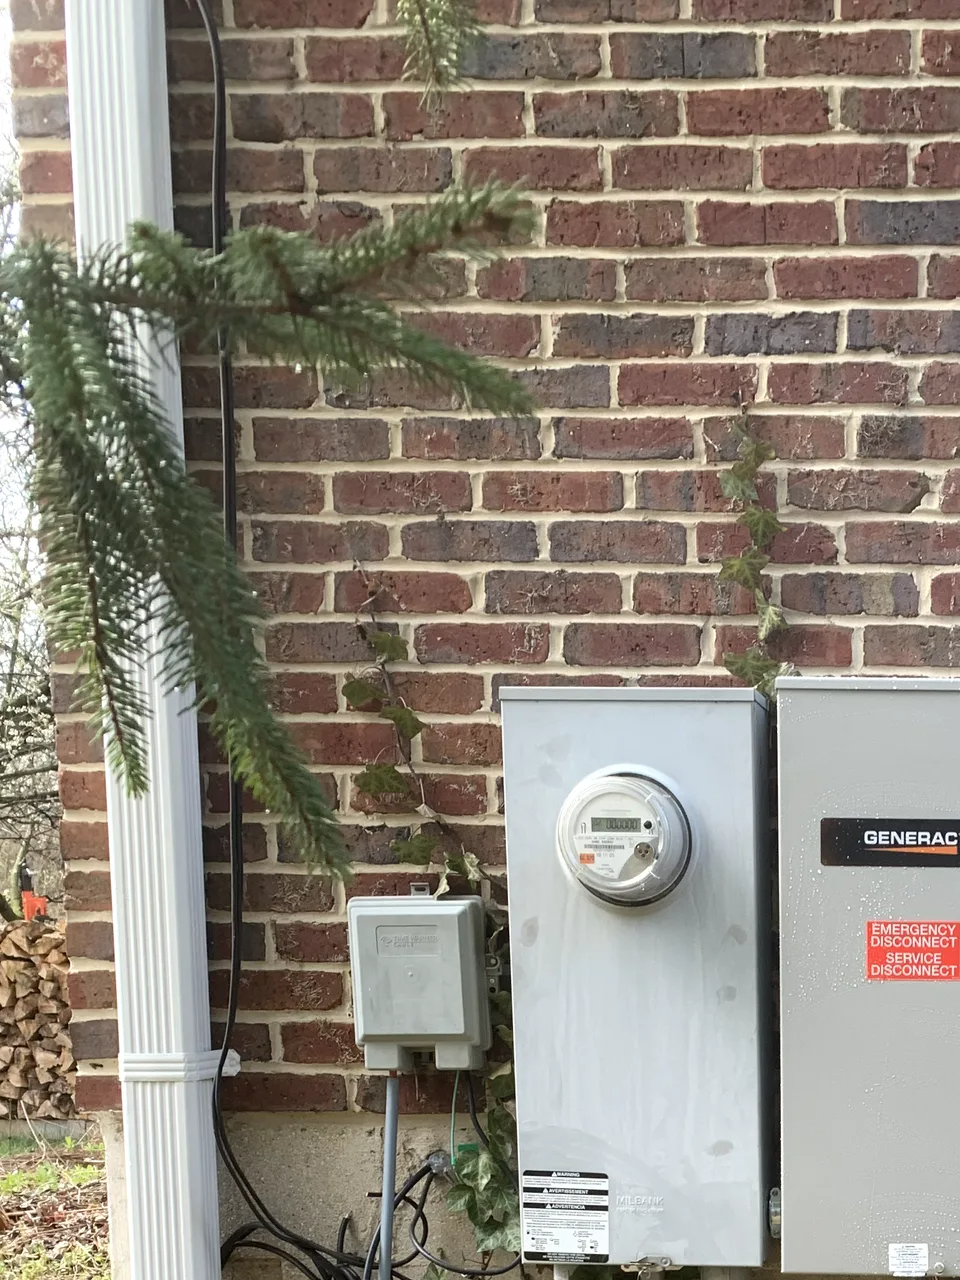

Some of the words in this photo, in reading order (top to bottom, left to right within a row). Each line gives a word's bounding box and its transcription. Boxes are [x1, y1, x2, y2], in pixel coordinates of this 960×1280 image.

[864, 831, 958, 846] GENERAC
[871, 923, 956, 936] EMERGENCY
[871, 936, 957, 948] DISCONNECT
[886, 952, 942, 964] SERVICE
[871, 964, 957, 976] DISCONNECT
[616, 1195, 664, 1206] MILBANK
